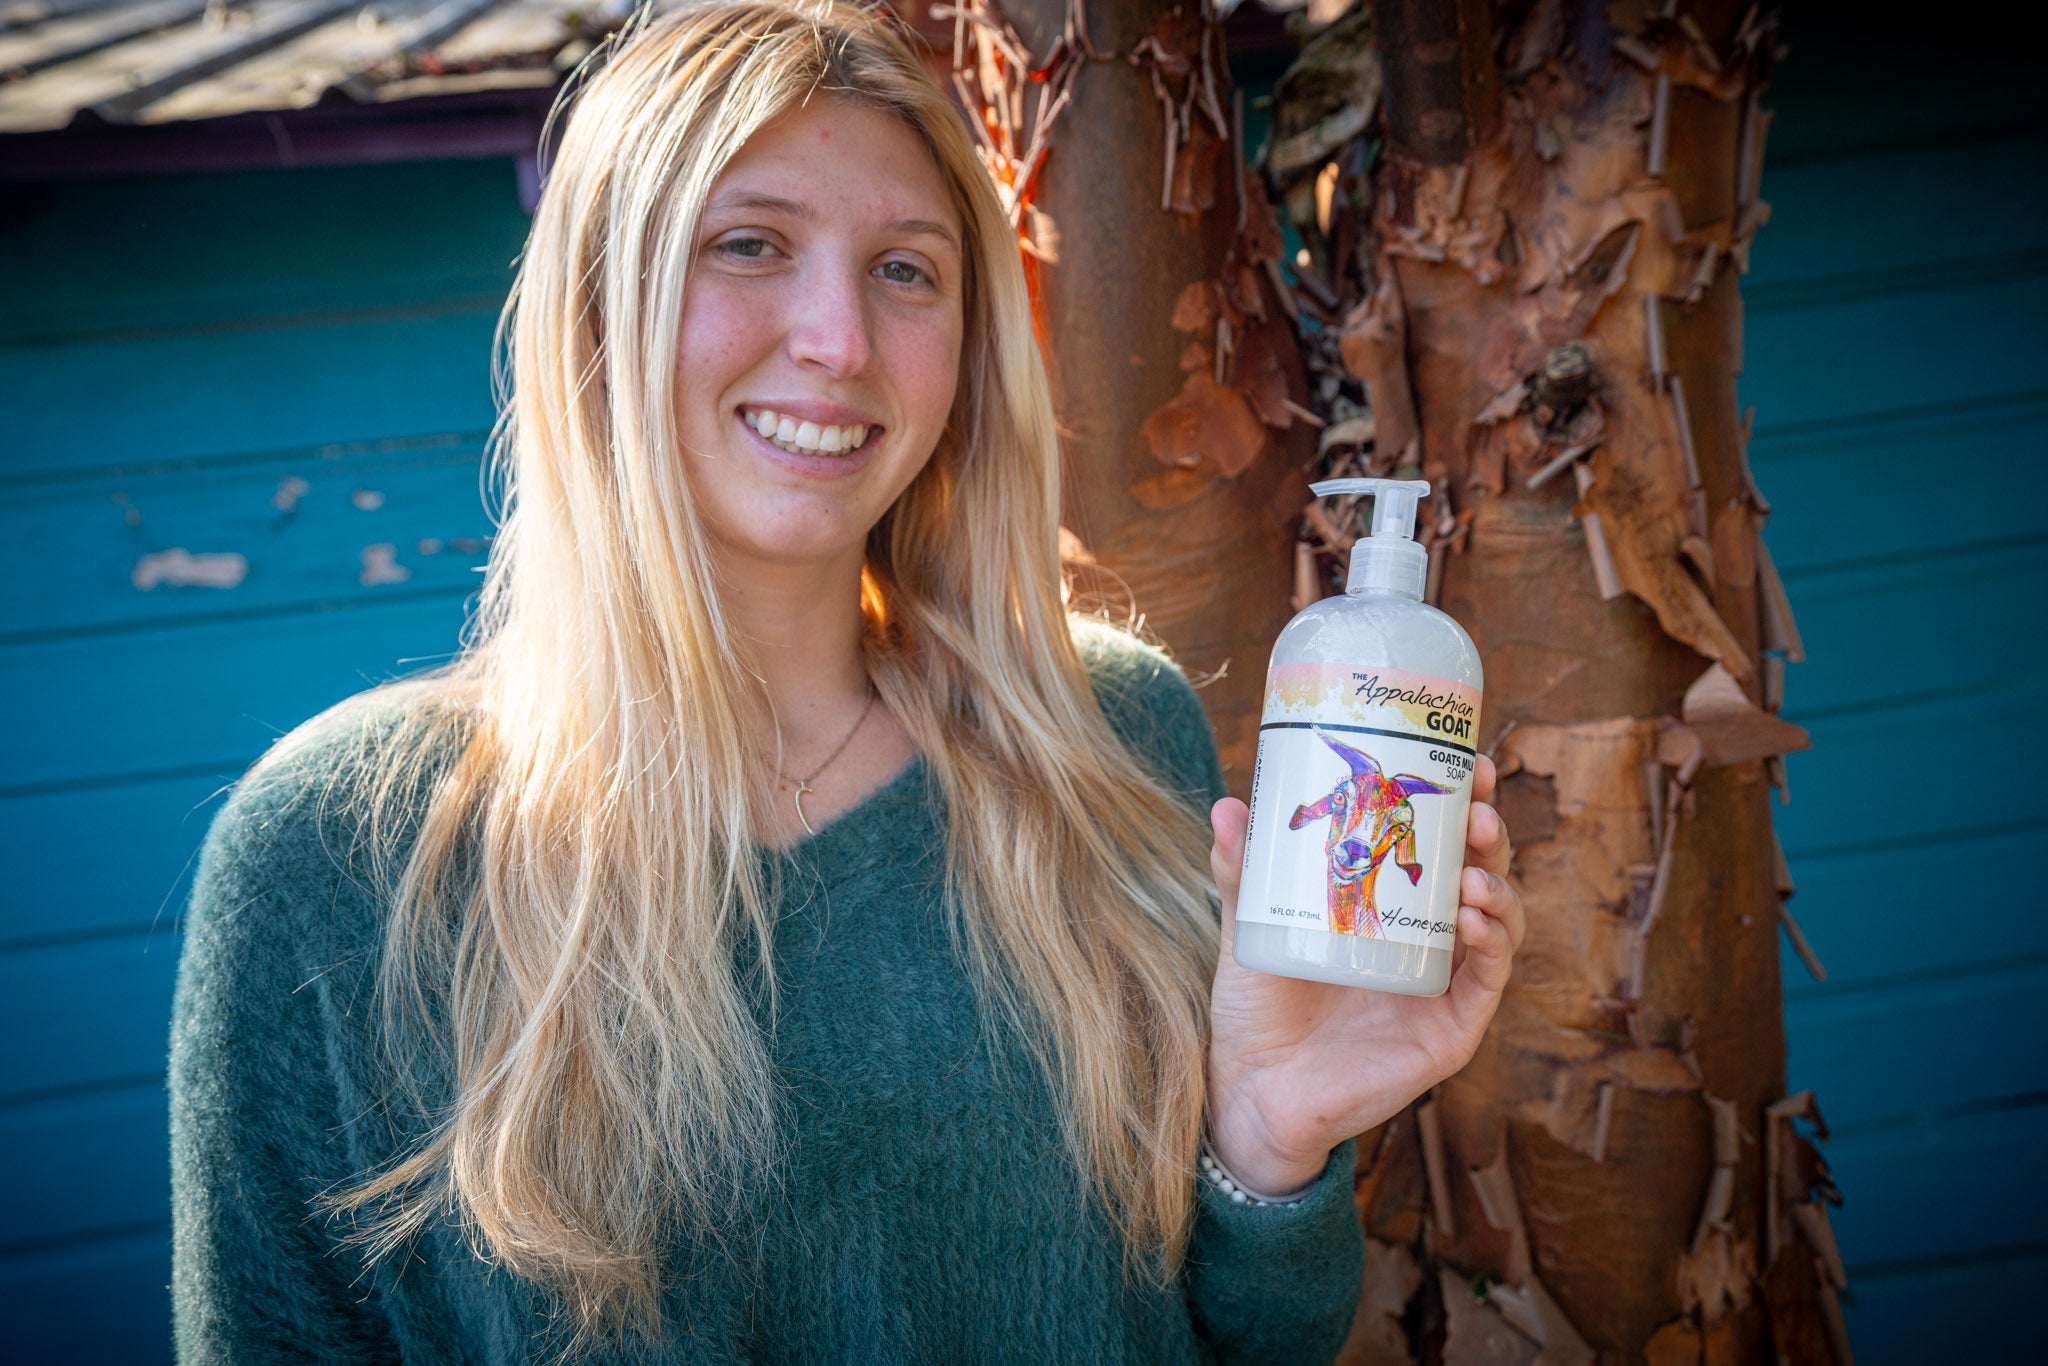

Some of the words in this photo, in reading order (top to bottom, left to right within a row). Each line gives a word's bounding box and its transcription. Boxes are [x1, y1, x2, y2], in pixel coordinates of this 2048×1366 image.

[1352, 672, 1368, 681] THE
[1355, 675, 1474, 718] Appalachian
[1426, 711, 1472, 739] GOAT
[1429, 749, 1461, 767] GOATS
[1446, 766, 1466, 781] SOAP
[1269, 906, 1277, 915] 16
[1277, 907, 1285, 916] FL
[1285, 908, 1295, 917] OZ
[1297, 910, 1322, 921] 473mL
[1381, 907, 1457, 937] Honeysuc
